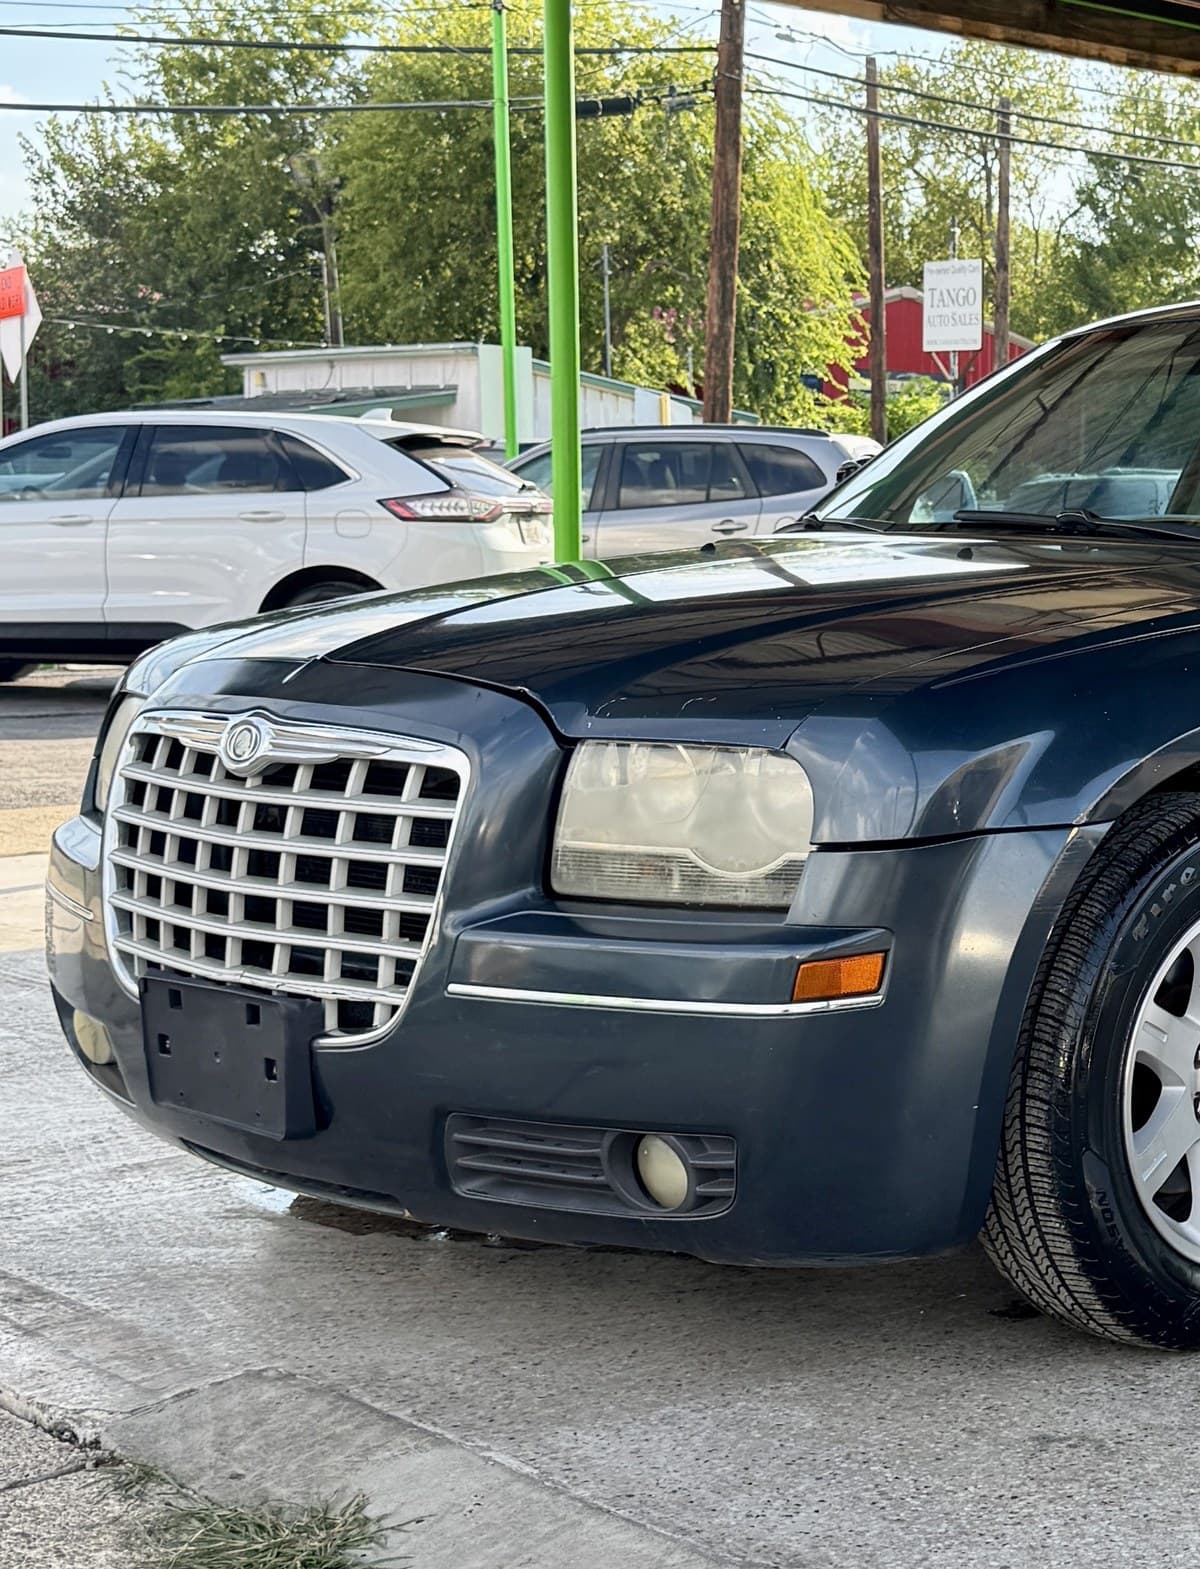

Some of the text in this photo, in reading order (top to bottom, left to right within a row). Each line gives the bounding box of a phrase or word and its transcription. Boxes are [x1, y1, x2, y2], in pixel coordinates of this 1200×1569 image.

[928, 287, 977, 308] TANGO
[927, 313, 980, 328] AUTO SALES
